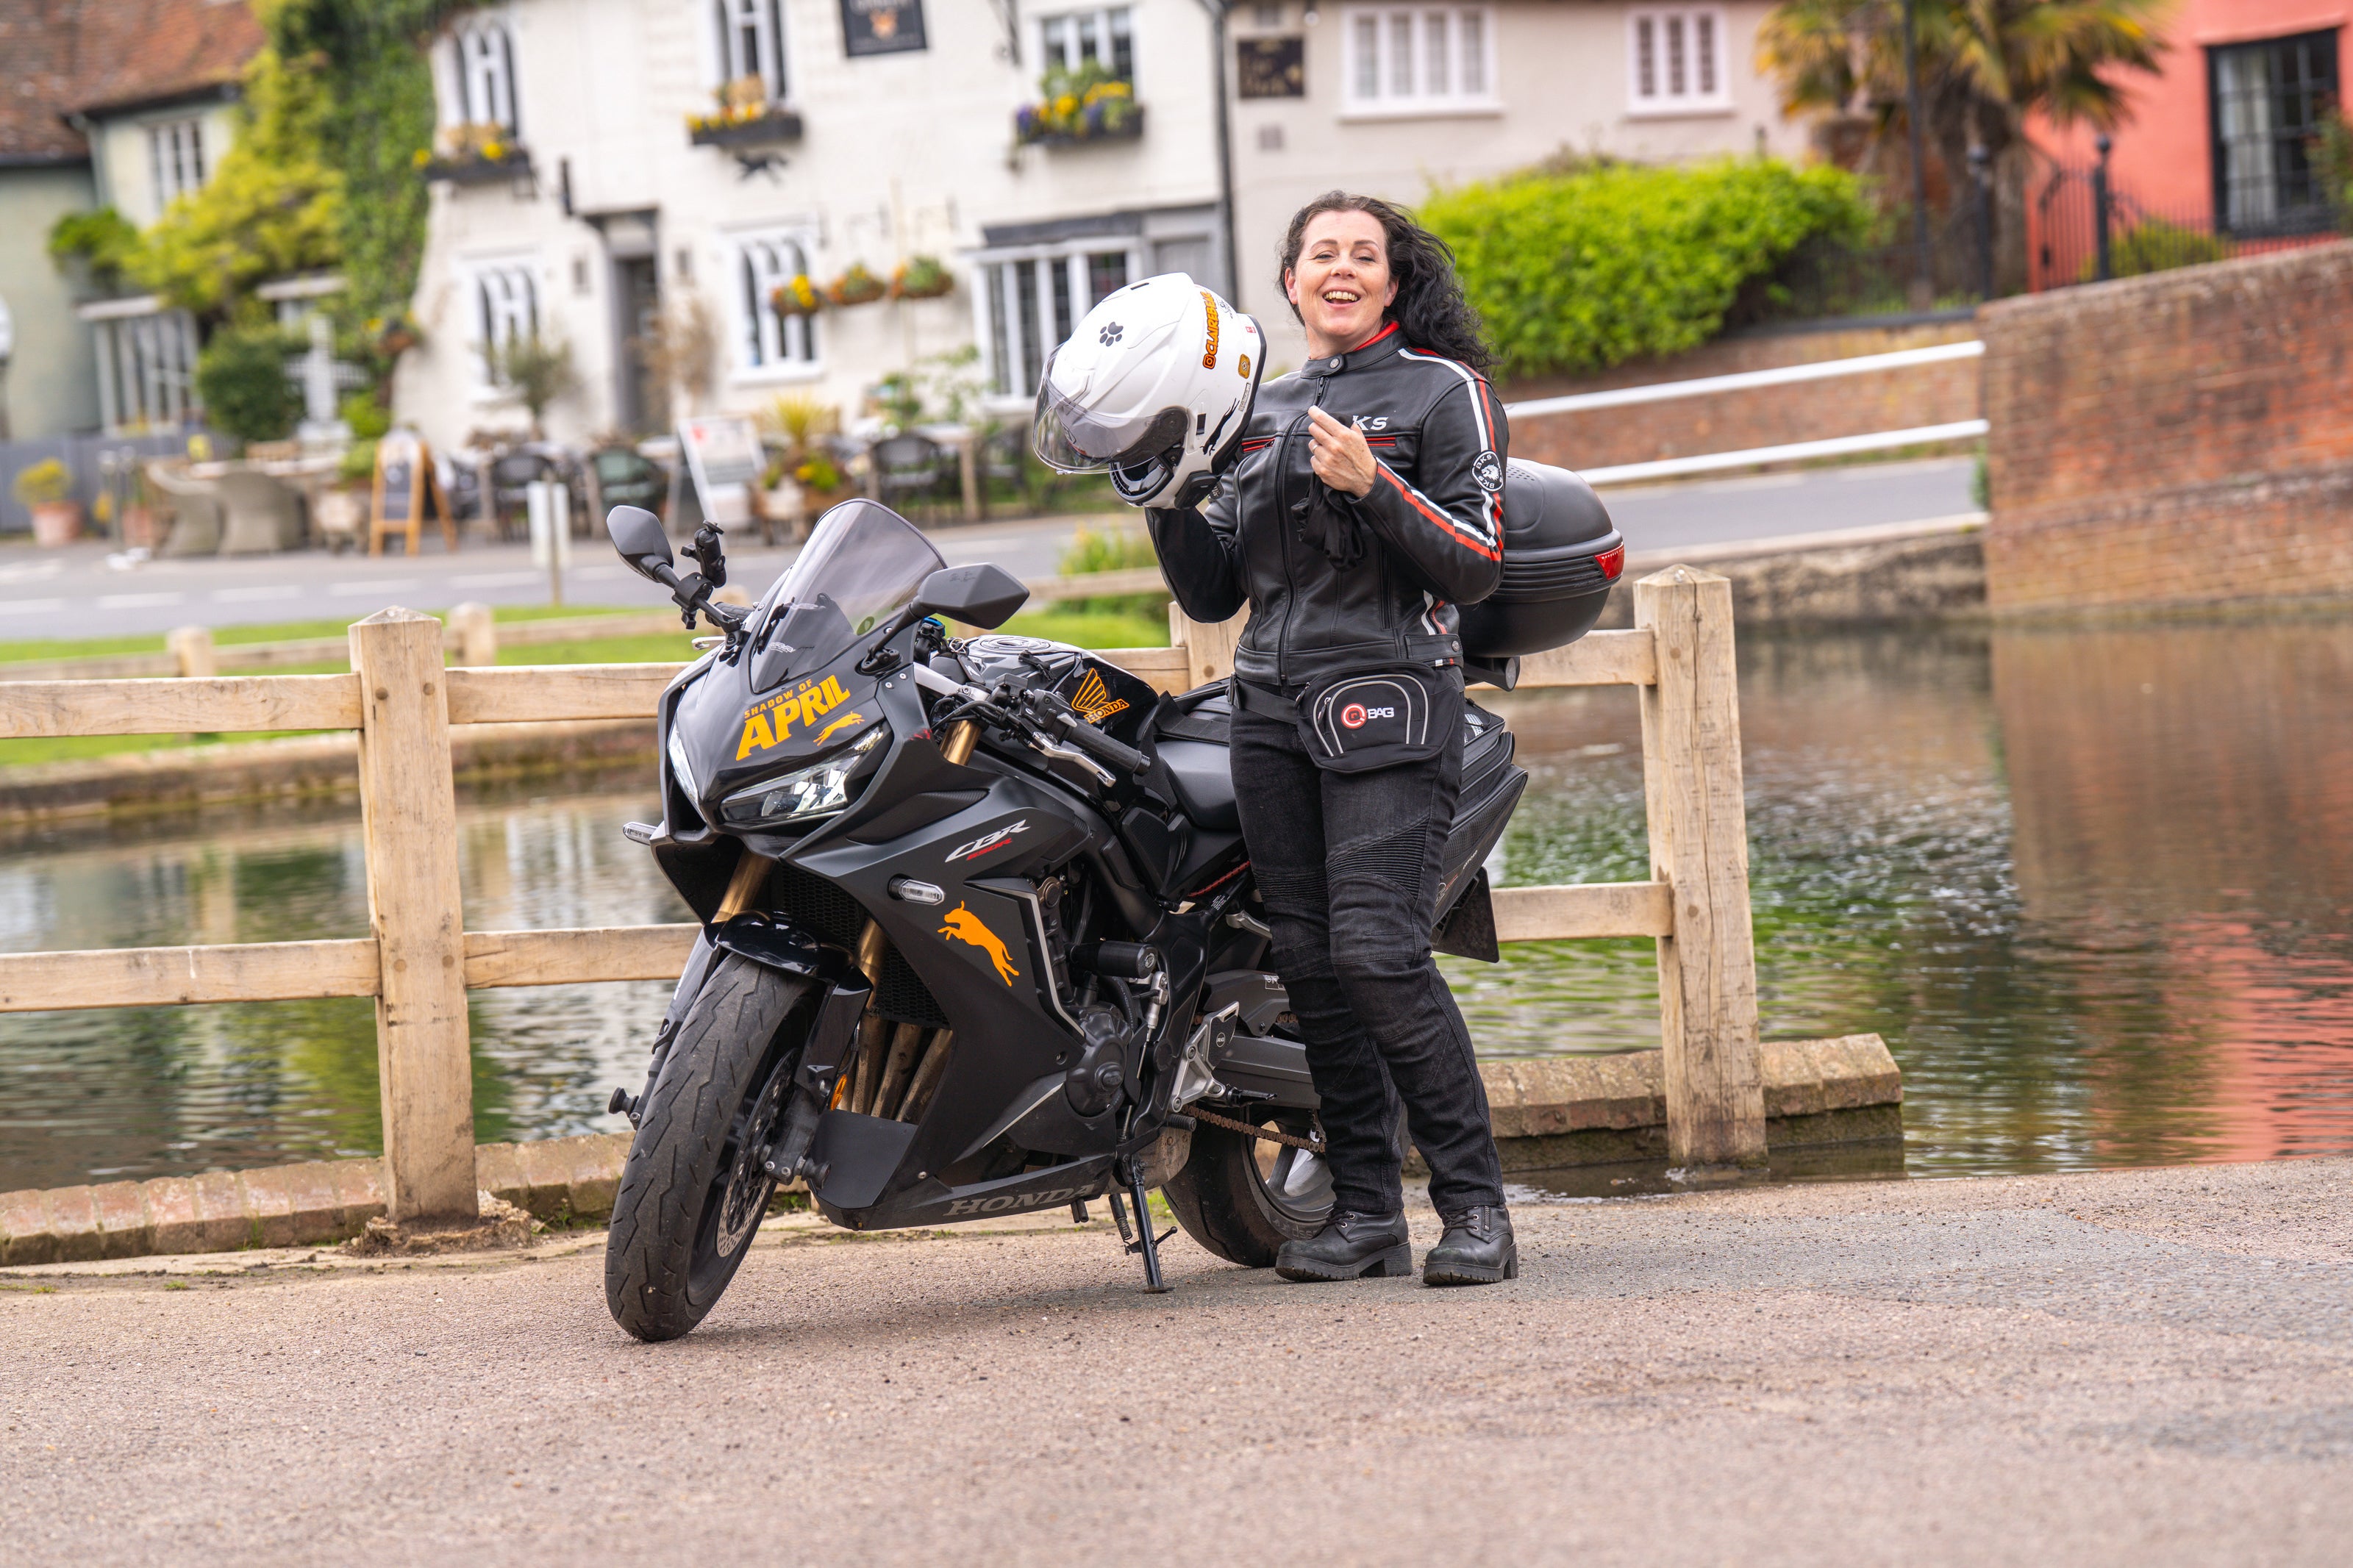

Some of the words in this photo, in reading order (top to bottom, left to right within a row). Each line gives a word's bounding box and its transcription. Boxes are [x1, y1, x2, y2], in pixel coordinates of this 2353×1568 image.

[1352, 415, 1389, 431] KS
[1476, 454, 1492, 470] BKS
[1478, 475, 1495, 489] BKS
[743, 690, 793, 719] SHADOW
[799, 679, 813, 692] OF
[1085, 699, 1129, 723] HONDA
[735, 674, 851, 762] APRIL
[1367, 707, 1395, 719] BAG
[945, 819, 1031, 863] CBR
[943, 1184, 1095, 1217] HONDA
